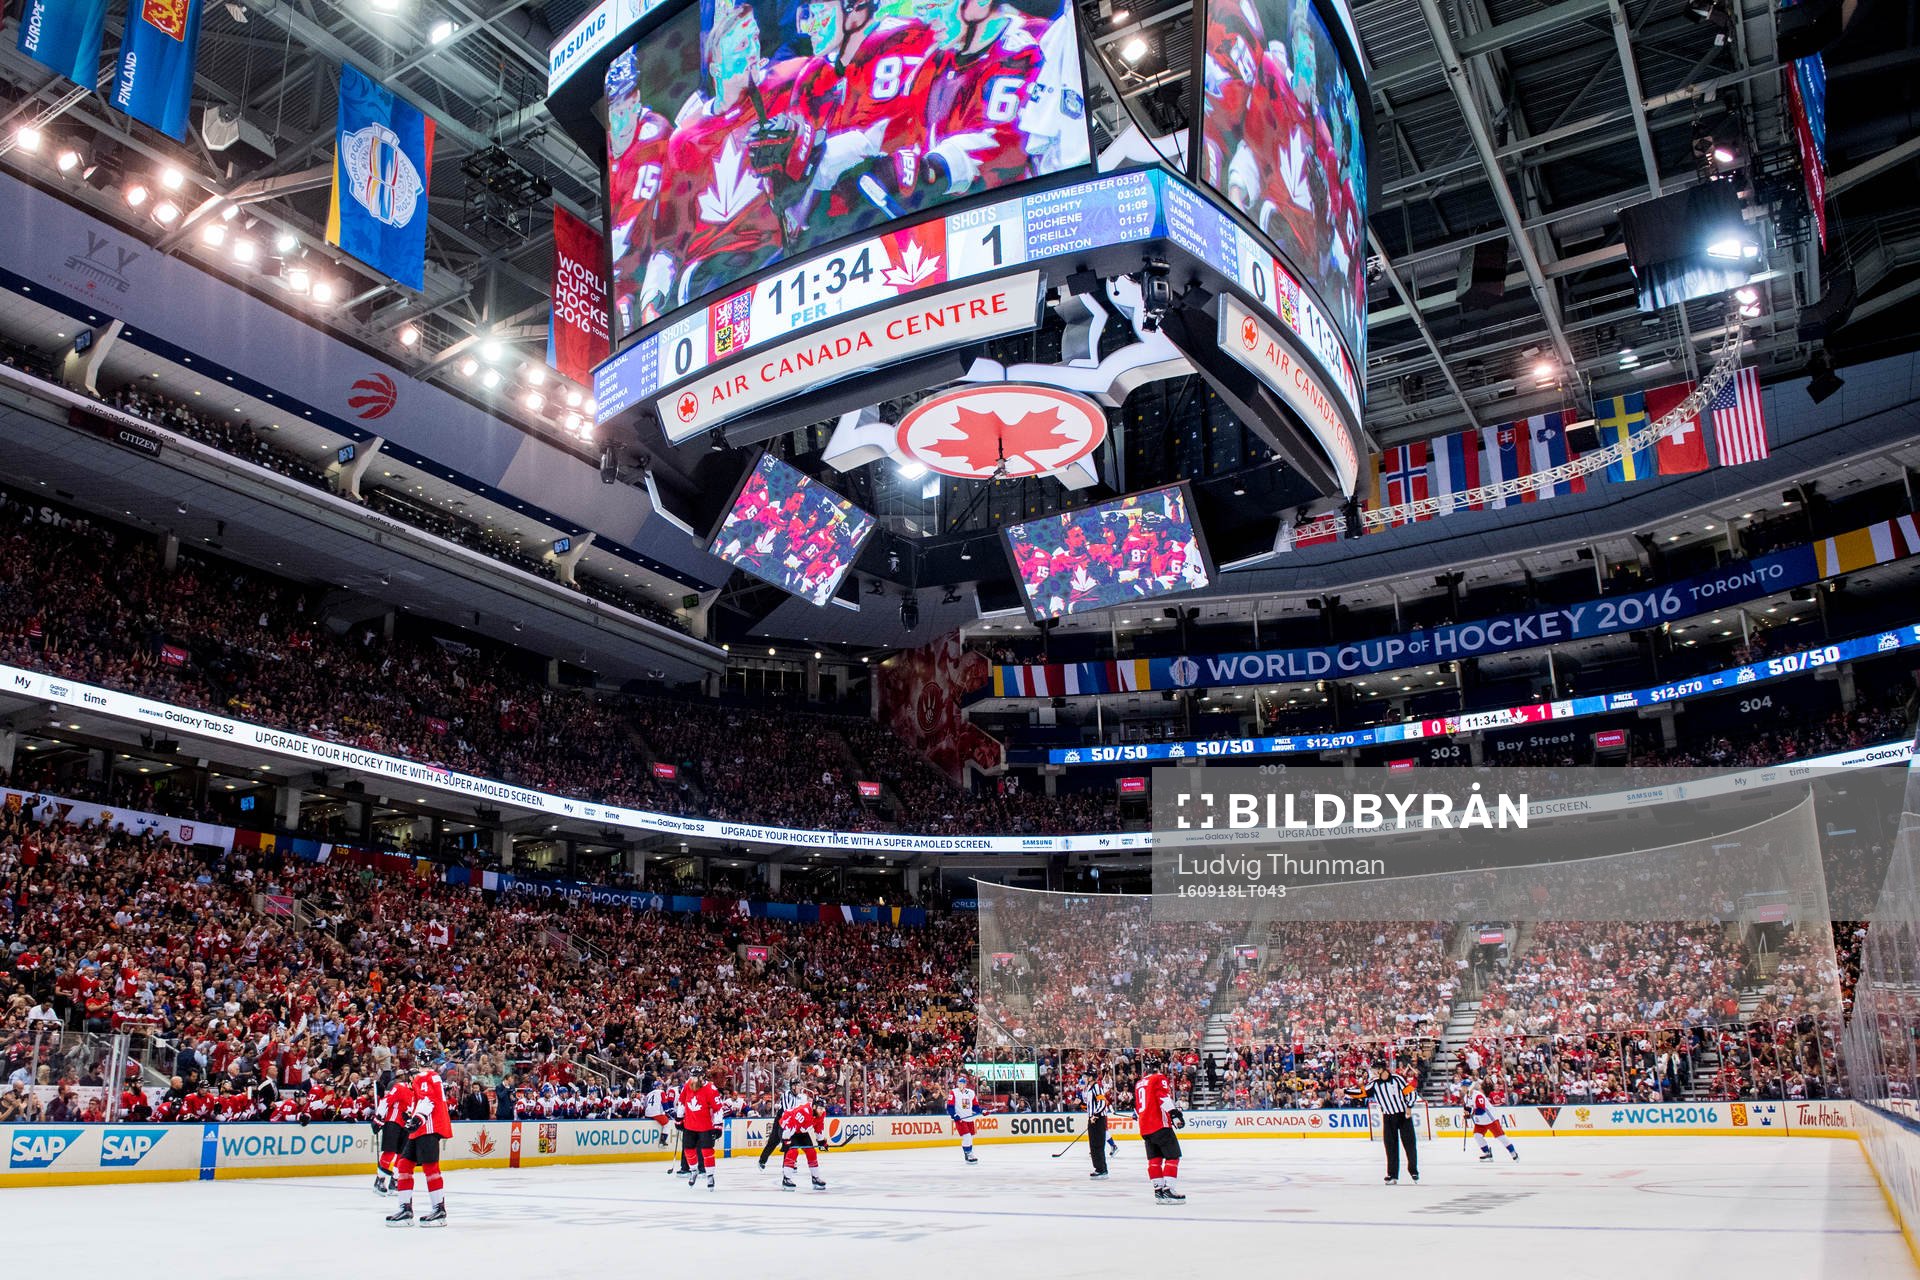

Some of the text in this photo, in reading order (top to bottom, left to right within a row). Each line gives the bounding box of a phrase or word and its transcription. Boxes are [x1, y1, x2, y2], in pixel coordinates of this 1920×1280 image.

[25, 0, 45, 51] EUROPE
[118, 51, 137, 106] FINLAND
[871, 56, 923, 99] 87
[632, 163, 662, 201] 15
[1026, 173, 1146, 206] BOUWMEESTER 03:07
[1027, 187, 1147, 219] DOUGHTY 03:02
[952, 206, 997, 232] SHOTS
[1028, 212, 1083, 232] DUCHENE
[982, 224, 1002, 266] 1
[1029, 226, 1079, 245] O'REILLY
[1029, 226, 1150, 259] THORNTON 01:18
[557, 269, 601, 303] CUP OF
[768, 247, 873, 315] 11:34
[1252, 260, 1266, 303] 0
[555, 284, 609, 329] HOCKE
[791, 302, 827, 328] PER
[554, 301, 591, 333] 2016
[1306, 303, 1344, 374] 11:34
[674, 337, 693, 375] 0
[711, 292, 1008, 405] AIR CANADA CENTRE
[1265, 342, 1336, 431] AIR CANADA
[119, 431, 158, 451] CITIZEN
[1207, 563, 1784, 680] WORLD CUP OF HOCKEY 2016 TORONTO
[1768, 645, 1841, 676] 50/50
[15, 675, 32, 690] My
[1650, 680, 1703, 702] $12,670
[83, 692, 107, 706] time
[1739, 695, 1773, 713] 304
[138, 707, 235, 735] SAMSUNG Galaxy Tab S2
[1465, 714, 1499, 728] 11:34
[1537, 706, 1546, 720] 1
[1560, 708, 1567, 716] 6
[1412, 729, 1418, 737] 6
[1431, 720, 1442, 734] 0
[1196, 738, 1255, 756] 50/50
[1306, 735, 1355, 748] $12,670
[1497, 732, 1576, 752] Bay Street
[1091, 744, 1148, 761] 50/50
[1431, 746, 1461, 760] 303
[1866, 747, 1904, 761] Galaxy
[255, 731, 545, 808] UPGRADE YOUR HOCKEY TIME WITH A SUPER AMOLED SCREEN.
[1258, 763, 1287, 776] 302
[1789, 766, 1810, 777] time
[1734, 777, 1748, 788] My
[1626, 789, 1664, 801] SAMSUNG
[564, 802, 574, 813] My
[604, 810, 620, 821] time
[1545, 800, 1592, 814] SCREEN.
[657, 818, 705, 832] Galaxy Tab S2
[1277, 827, 1326, 839] UPGRADE
[1327, 824, 1355, 836] YOUR
[721, 826, 993, 850] UPGRADE YOUR HOCKEY TIME WITH A SUPER AMOLED SCREEN.
[1099, 838, 1110, 847] My
[1144, 836, 1161, 845] time
[1205, 831, 1260, 841] Galaxy Tab S2
[592, 891, 646, 910] HOCKEY
[420, 1081, 429, 1092] 4
[1161, 1080, 1169, 1089] 9
[1138, 1087, 1147, 1113] 9
[795, 1112, 805, 1123] 90
[1010, 1115, 1075, 1135] sonnet
[1189, 1116, 1228, 1129] Synergy
[1235, 1115, 1306, 1127] AIR CANADA
[1328, 1113, 1421, 1129] SAMSG
[1611, 1107, 1718, 1125] #WCH2016
[1796, 1103, 1848, 1128] Tim Hortons
[575, 1129, 630, 1147] WORLD
[631, 1129, 660, 1145] CUP
[843, 1120, 875, 1141] pepsi
[891, 1121, 943, 1136] HONDA
[12, 1135, 67, 1162] SAP
[102, 1135, 152, 1161] SAP
[222, 1135, 307, 1158] WORLD
[310, 1134, 354, 1155] CUP
[355, 1138, 369, 1149] OF
